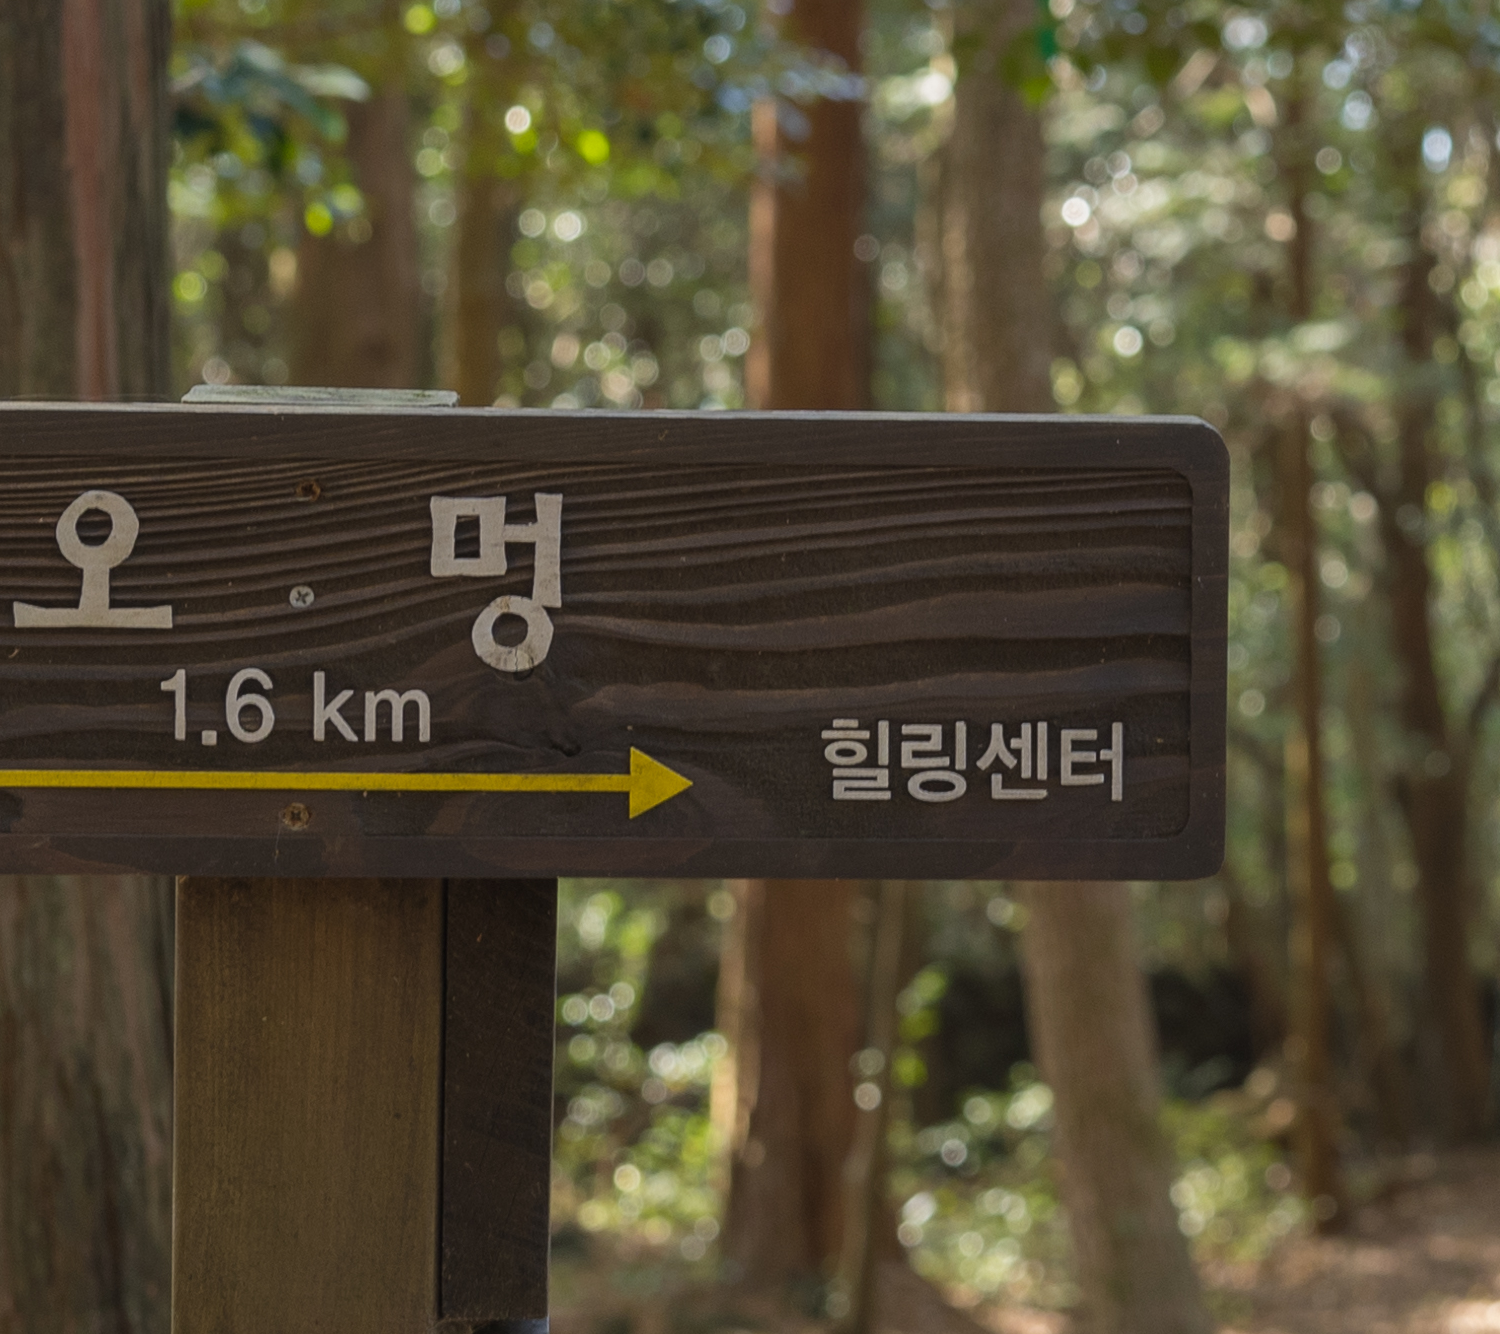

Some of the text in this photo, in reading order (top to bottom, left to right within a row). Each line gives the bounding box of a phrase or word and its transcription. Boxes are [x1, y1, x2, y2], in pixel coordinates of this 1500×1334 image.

[160, 667, 431, 745] 1.6 km
[820, 718, 1123, 802] 힐링센터
